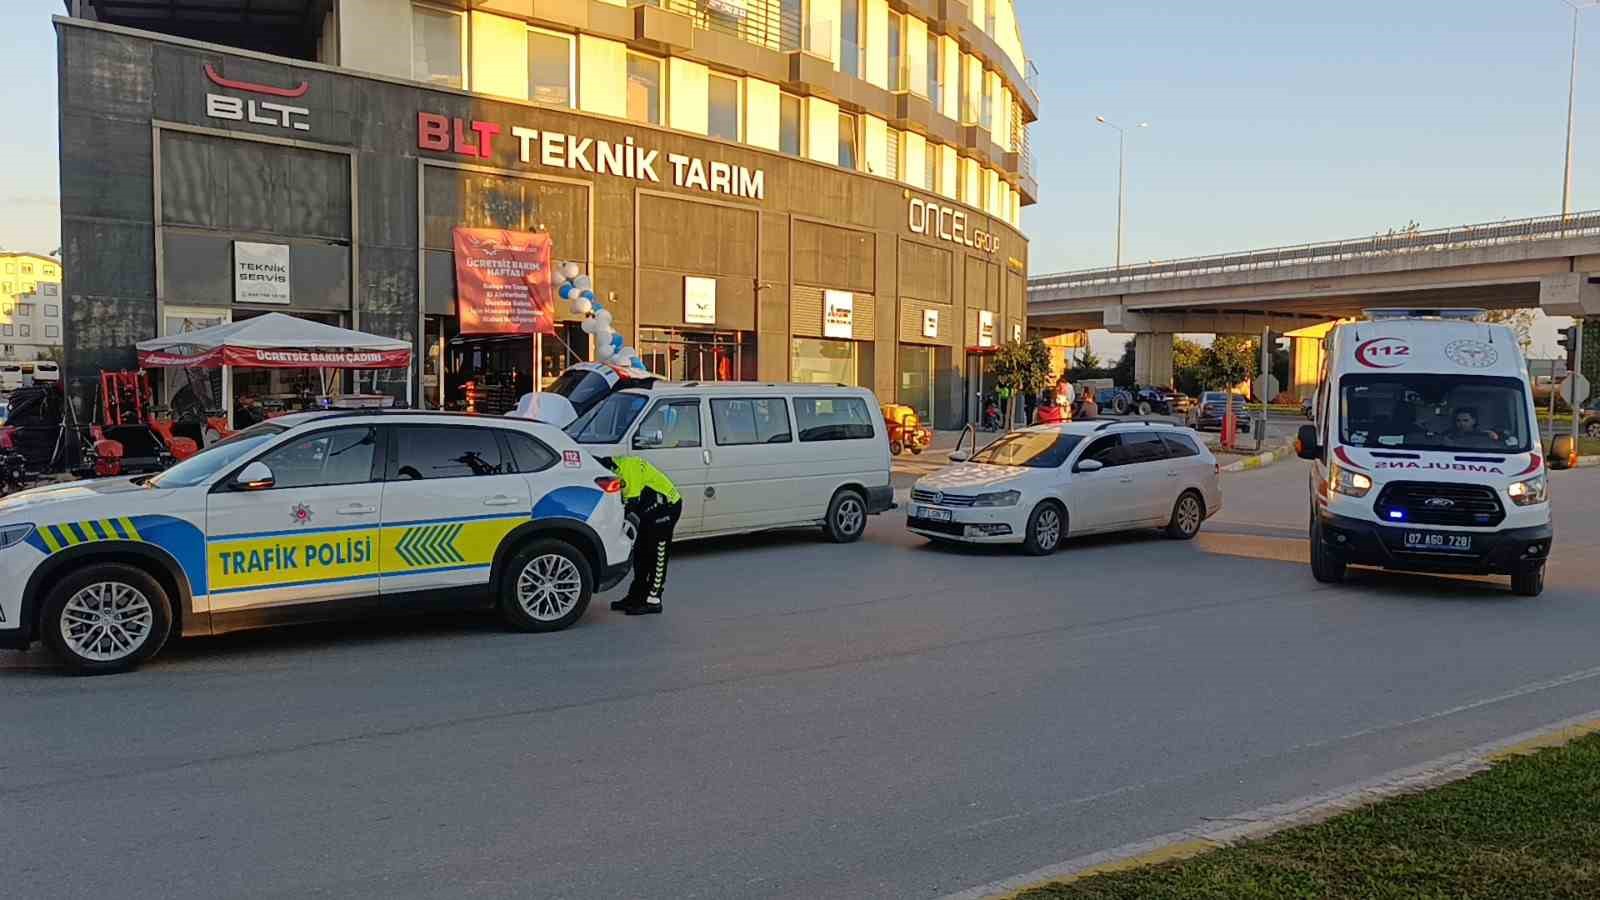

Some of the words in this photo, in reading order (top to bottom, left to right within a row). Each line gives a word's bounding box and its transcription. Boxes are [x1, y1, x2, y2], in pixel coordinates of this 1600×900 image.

[417, 112, 500, 160] BLT
[512, 126, 660, 183] TEKNİK
[667, 153, 765, 200] TARIM
[240, 262, 286, 272] TEKNİK
[240, 272, 286, 283] SERVİS
[1367, 345, 1409, 356] 112
[256, 349, 309, 361] ÜCRETSİZ
[310, 352, 344, 363] BAKIM
[346, 352, 382, 364] ÇADIRI
[564, 451, 579, 461] 112
[1408, 533, 1422, 544] 07
[219, 544, 299, 575] TRAFİK
[305, 536, 372, 567] POLİSİ
